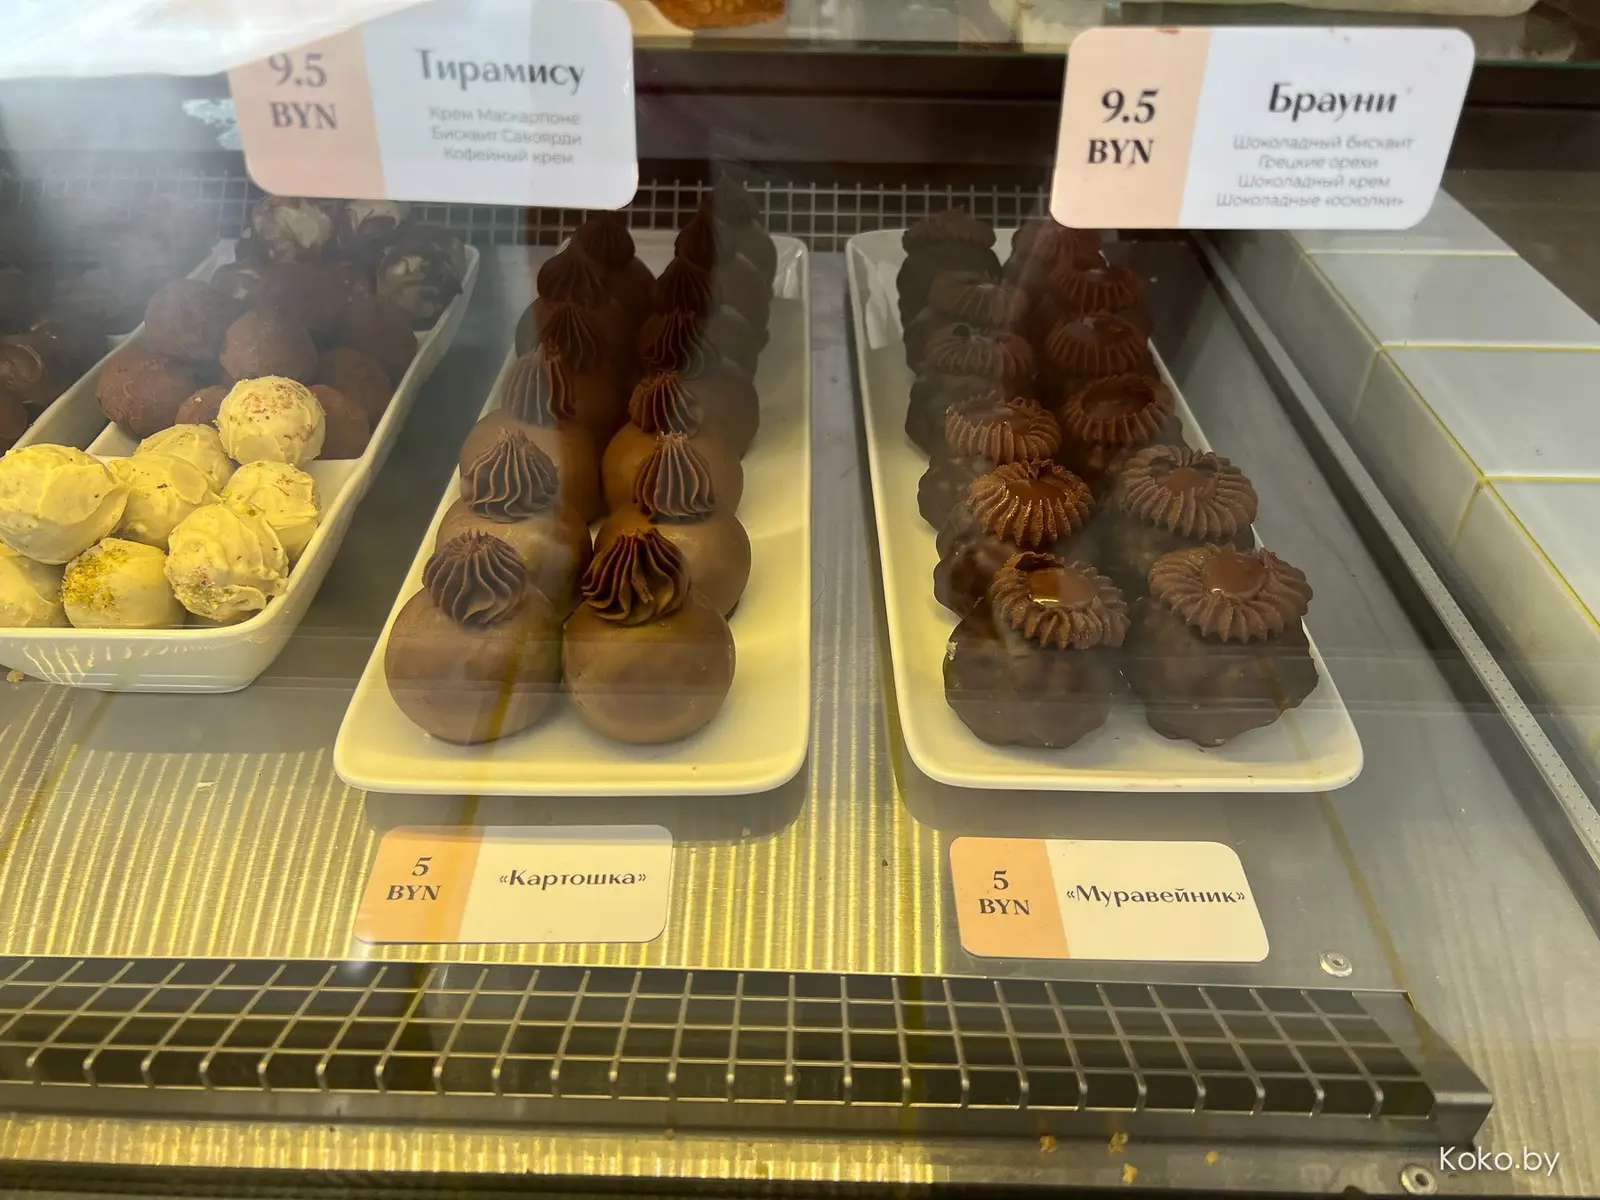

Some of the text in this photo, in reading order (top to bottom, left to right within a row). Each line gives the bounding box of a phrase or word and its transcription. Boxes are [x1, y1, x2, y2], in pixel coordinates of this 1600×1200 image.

[268, 52, 328, 89] 9.5
[414, 48, 585, 94] Тирамису
[1101, 88, 1158, 124] 9.5
[1268, 82, 1398, 122] Брауни
[270, 102, 339, 131] BYN
[429, 106, 581, 126] Крем Маскарпоне
[432, 125, 582, 148] Бисквит Савоярди
[1233, 135, 1414, 150] Шоколадный бисквит
[444, 147, 574, 166] Кофейный крем
[1086, 139, 1154, 165] BYN
[1259, 155, 1379, 171] Грецкие орехи
[1238, 175, 1391, 191] Шоколадный крем
[1216, 194, 1320, 208] Шоколадные
[411, 856, 432, 876] 5
[499, 869, 647, 891] «Картошка»
[992, 869, 1009, 890] 5
[386, 885, 441, 901] BYN
[1066, 885, 1245, 907] «Муравейник»
[978, 898, 1030, 915] BYN
